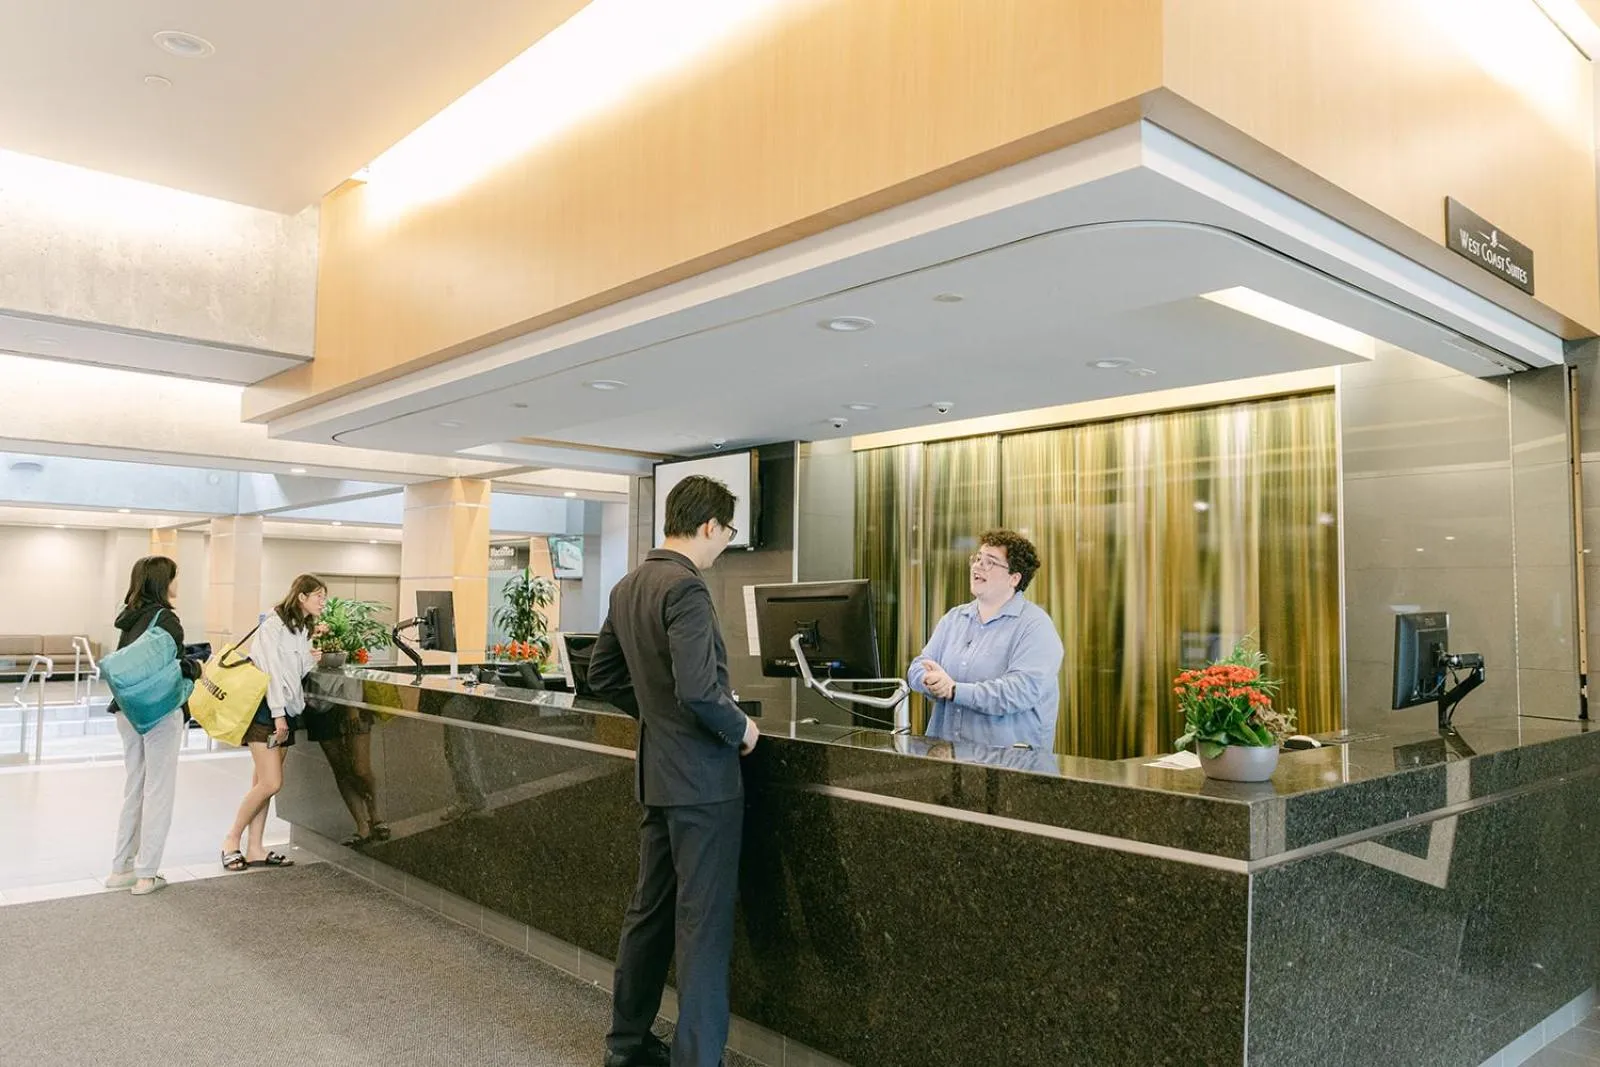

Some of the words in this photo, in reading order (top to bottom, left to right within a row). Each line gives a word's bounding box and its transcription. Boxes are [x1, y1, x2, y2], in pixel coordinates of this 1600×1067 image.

[1459, 229, 1481, 256] WEST
[1481, 243, 1505, 271] COAST
[1505, 257, 1528, 284] SUITES
